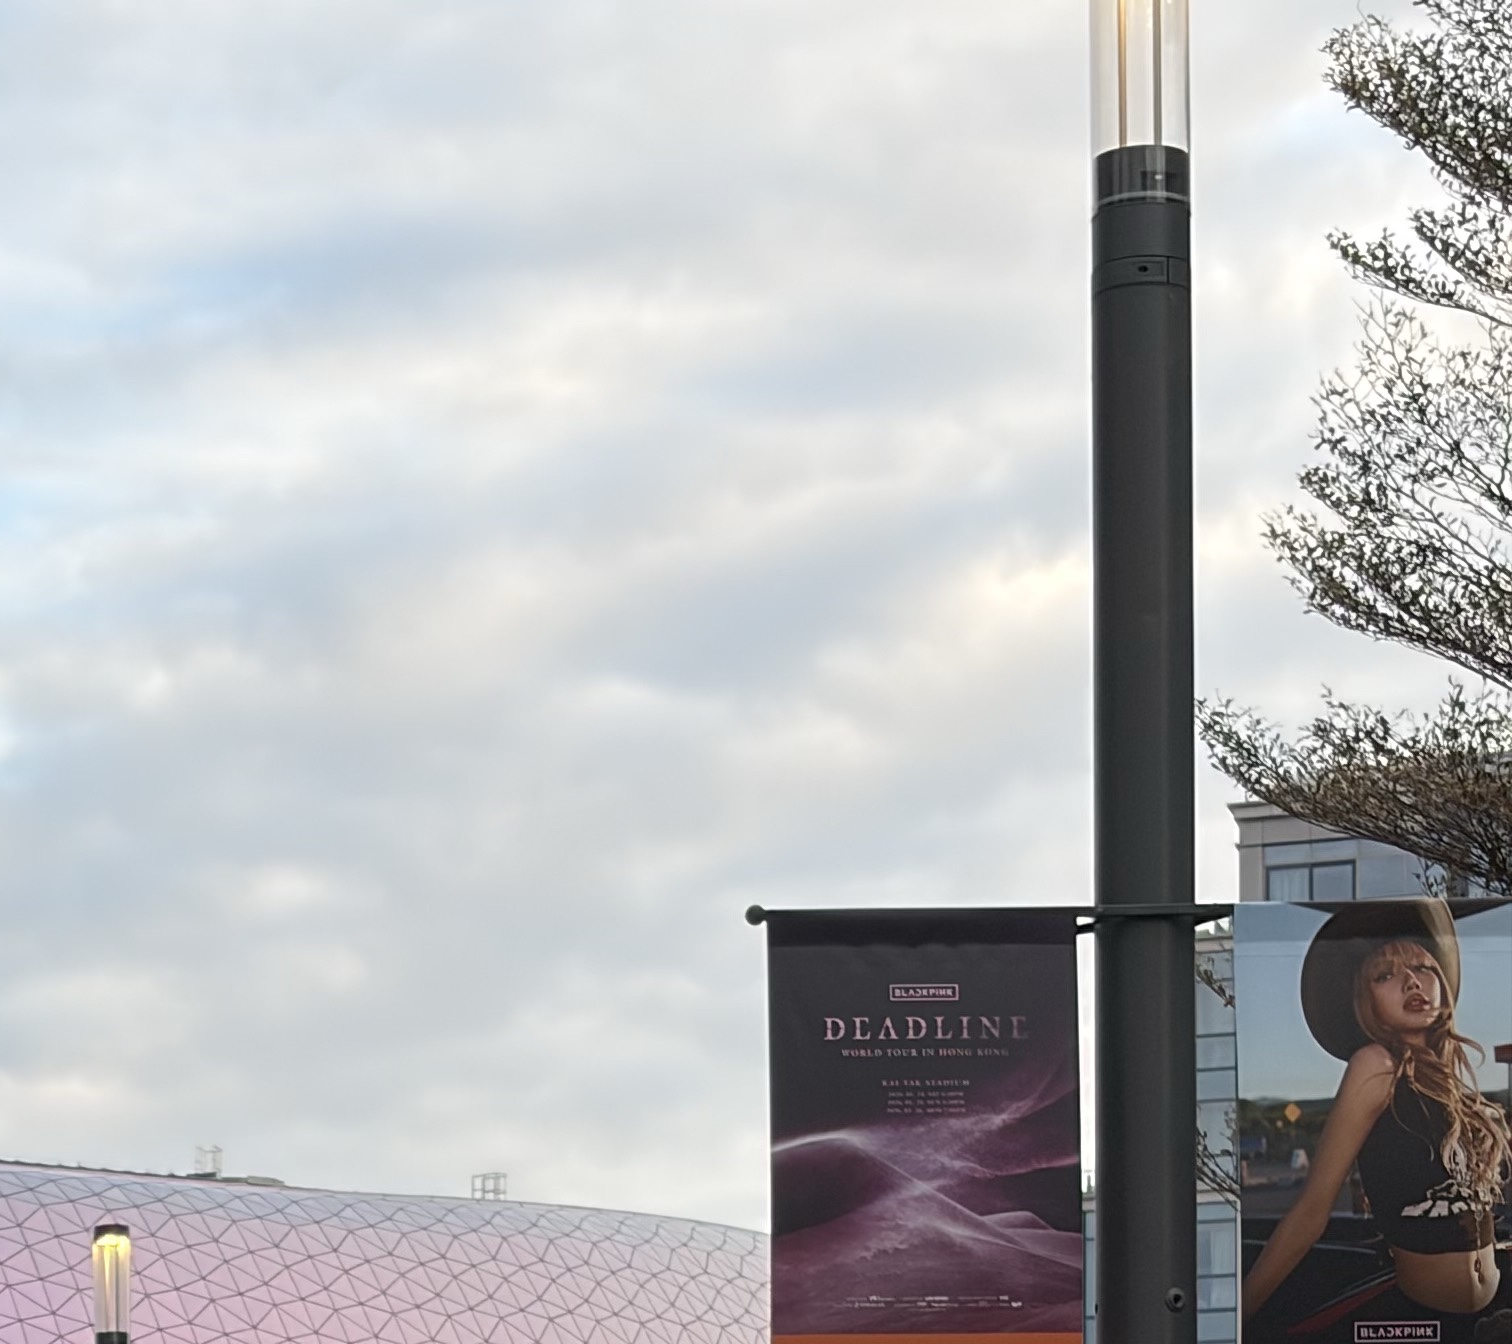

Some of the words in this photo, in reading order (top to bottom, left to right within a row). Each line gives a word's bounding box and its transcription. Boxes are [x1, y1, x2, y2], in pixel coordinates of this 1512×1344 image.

[824, 1016, 1029, 1041] DEADLINE
[841, 1048, 882, 1057] WORLD
[885, 1048, 918, 1057] TOUR
[922, 1048, 934, 1057] IN
[939, 1048, 972, 1057] HONG
[977, 1048, 1009, 1057] KONG
[1358, 1325, 1437, 1339] BLACKPINK
